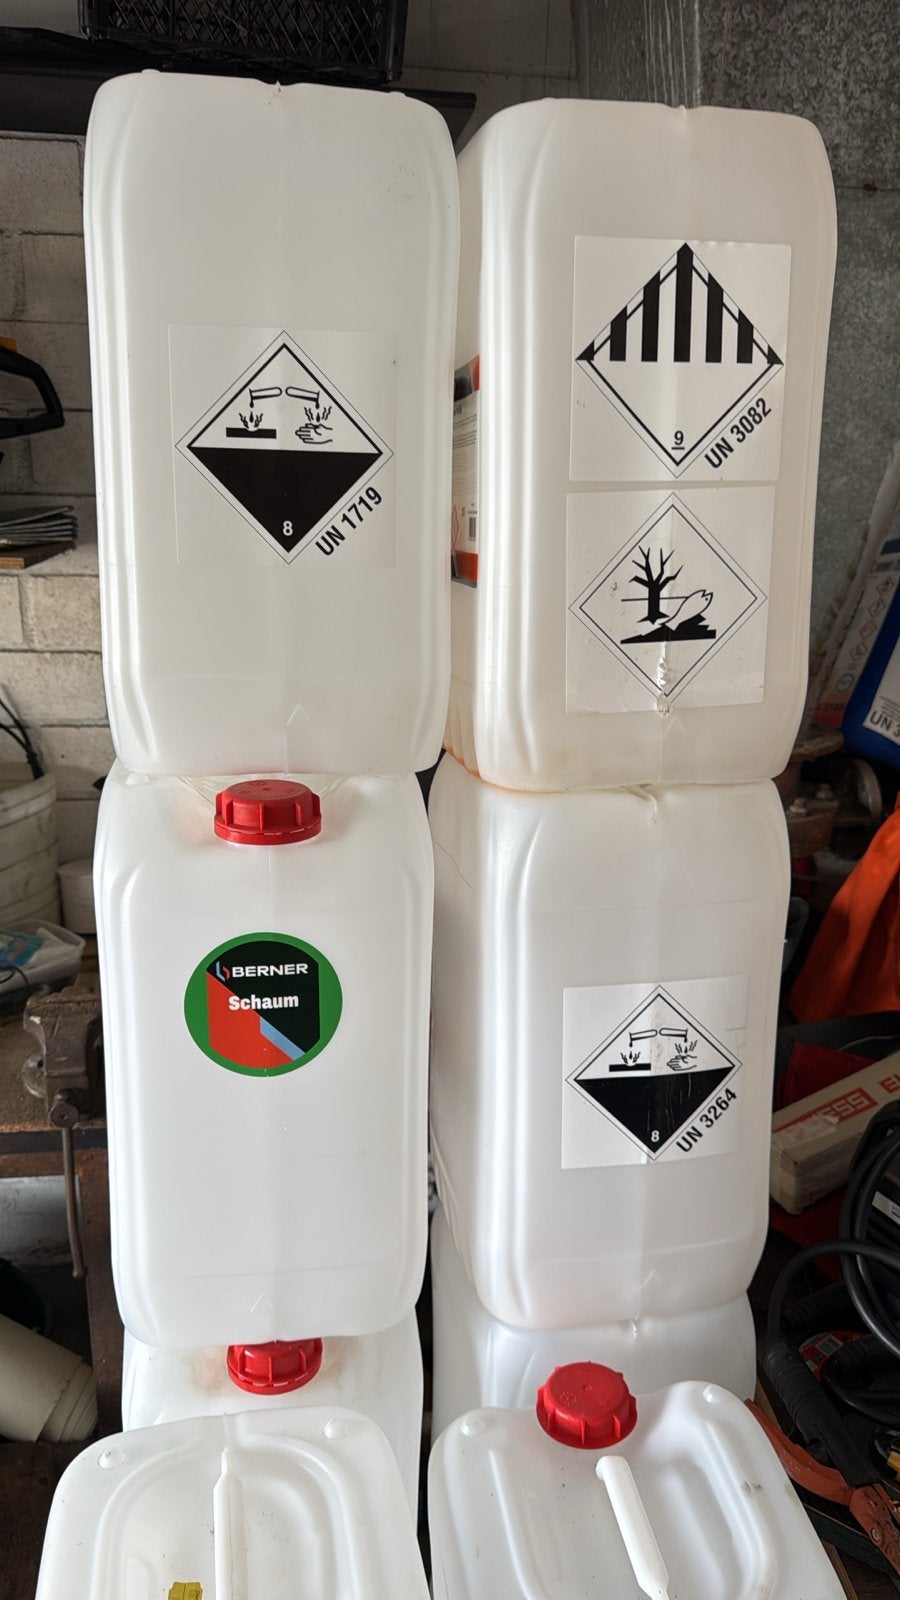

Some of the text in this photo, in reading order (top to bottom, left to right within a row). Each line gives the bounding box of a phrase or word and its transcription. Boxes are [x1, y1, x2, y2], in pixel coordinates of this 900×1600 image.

[674, 430, 684, 446] 9
[704, 397, 772, 469] UN 3082
[282, 520, 294, 537] 8
[315, 486, 383, 556] UN 1719
[870, 711, 892, 731] UN
[232, 963, 309, 978] BERNER
[228, 994, 299, 1011] Schaum
[675, 1087, 738, 1153] UN 3264
[650, 1130, 660, 1143] 8
